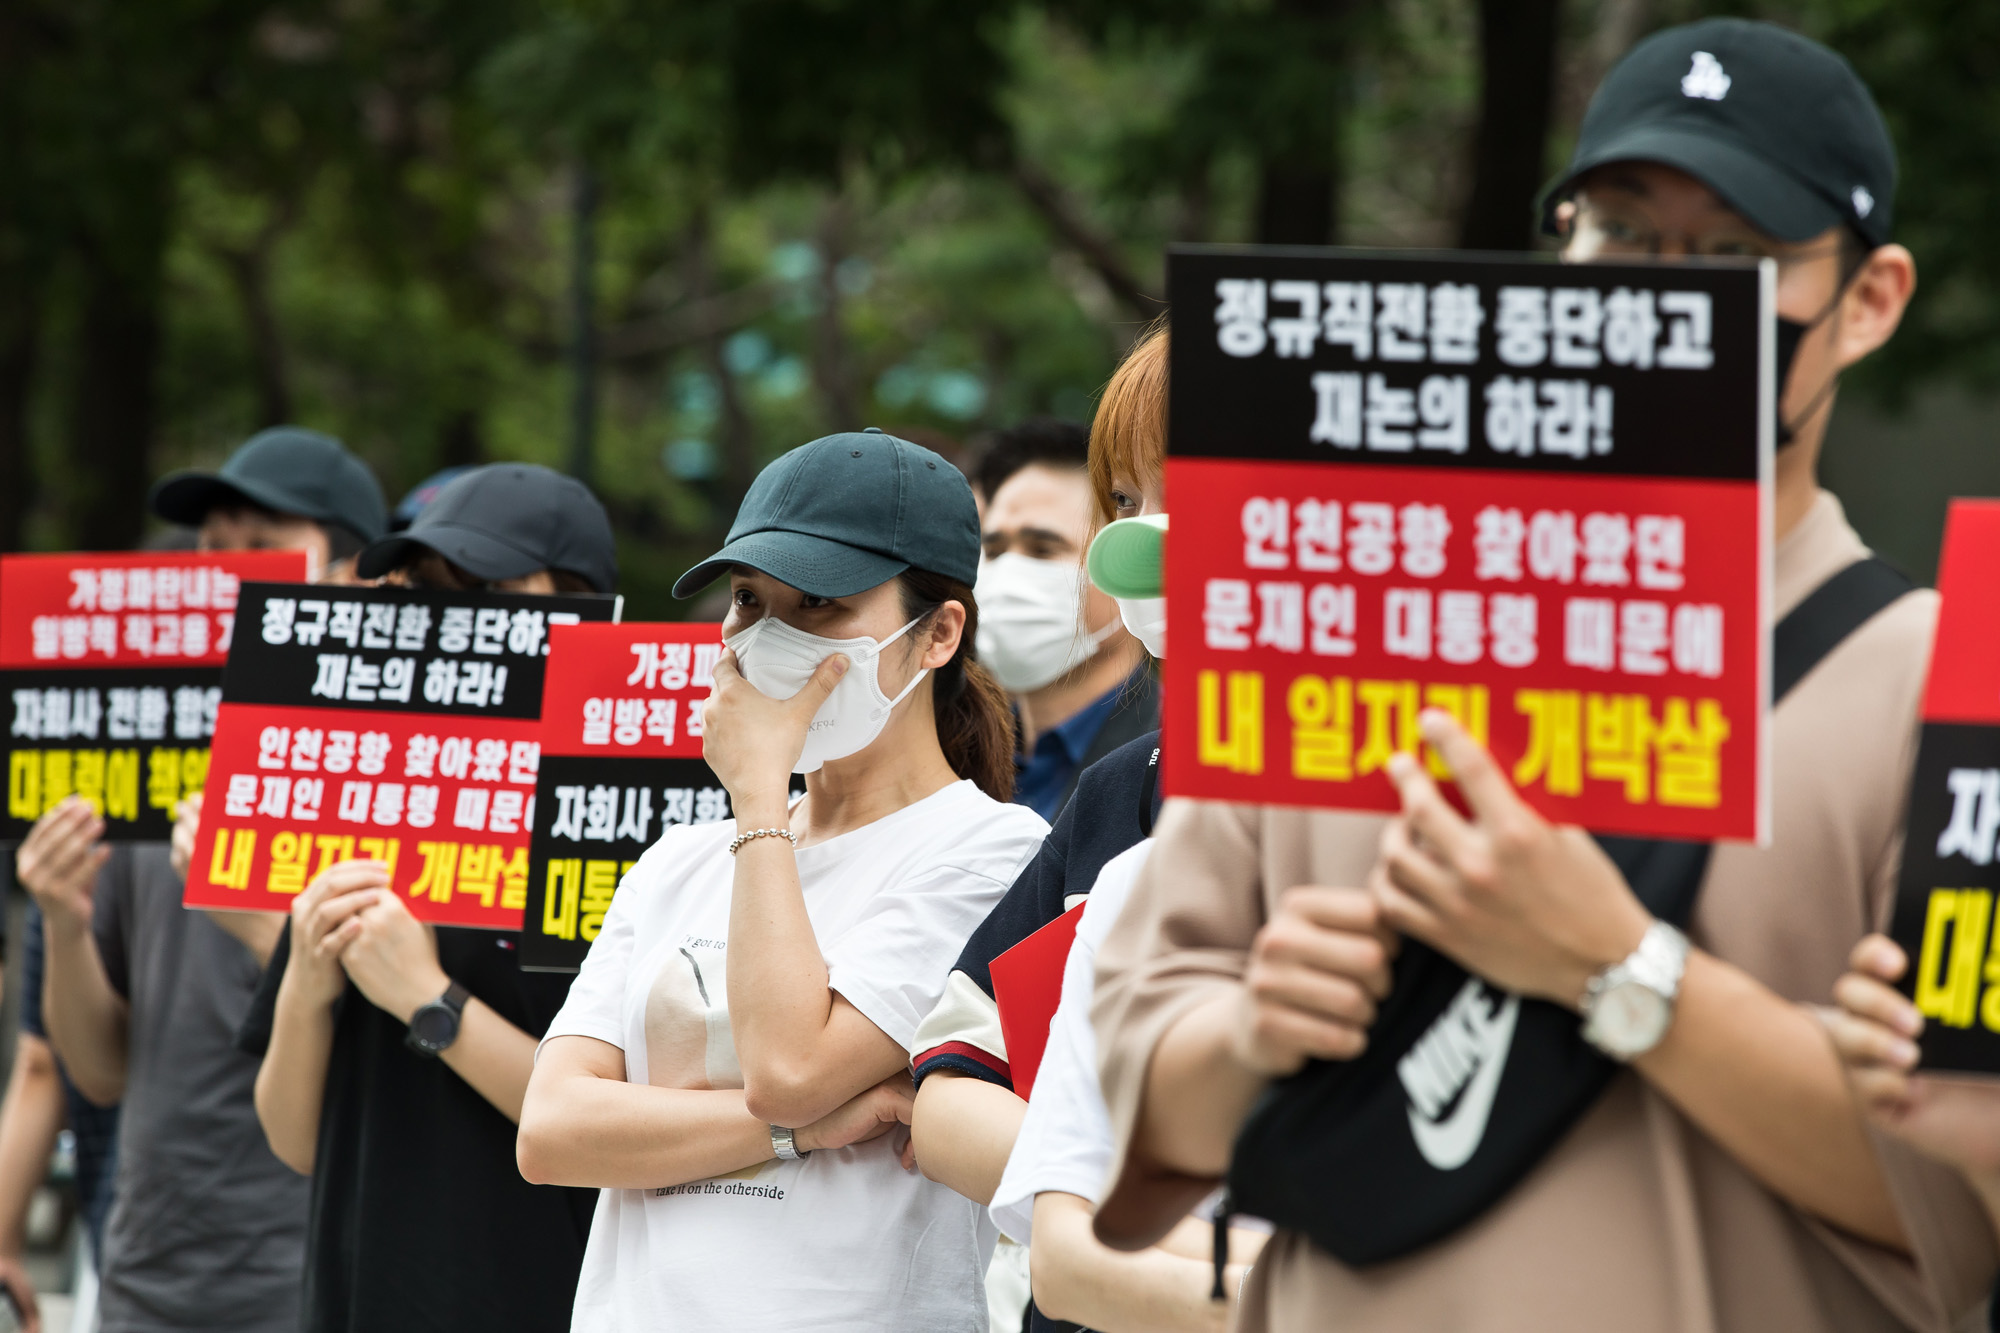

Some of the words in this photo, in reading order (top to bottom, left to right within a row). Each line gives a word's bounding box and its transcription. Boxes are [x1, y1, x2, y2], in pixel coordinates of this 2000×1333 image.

[1215, 278, 1485, 363] 정규직전환
[1496, 286, 1713, 369] 중단하고
[1311, 371, 1470, 453] 재논의
[1485, 375, 1613, 459] 하라!
[1241, 497, 1451, 578] 인천공항
[1474, 506, 1685, 590] 찾아왔던
[261, 597, 432, 650] 정규직전환
[1203, 578, 1356, 656] 문재인
[1383, 587, 1538, 667] 대통령
[1564, 597, 1723, 678] 때문에
[311, 653, 416, 703] 재논의
[423, 658, 508, 708] 하라!
[11, 687, 102, 740] 자회사
[106, 686, 169, 740] 전환
[582, 697, 678, 747] 일방적
[1197, 670, 1264, 774] 내
[1287, 674, 1490, 783] 일자리
[1514, 689, 1730, 810] 개박살
[257, 726, 392, 776] 인천공항
[404, 733, 541, 785] 찾아왔던
[224, 773, 324, 821] 문재인
[337, 780, 440, 829] 대통령
[550, 784, 653, 843] 자회사
[207, 827, 258, 891] 내
[542, 857, 637, 943] 대통
[691, 938, 713, 949] got
[713, 940, 726, 950] to
[1397, 977, 1499, 1120] NIKE
[656, 1184, 676, 1197] take
[677, 1183, 686, 1195] it
[687, 1183, 702, 1195] on
[703, 1182, 722, 1195] the
[724, 1182, 785, 1200] otherside
